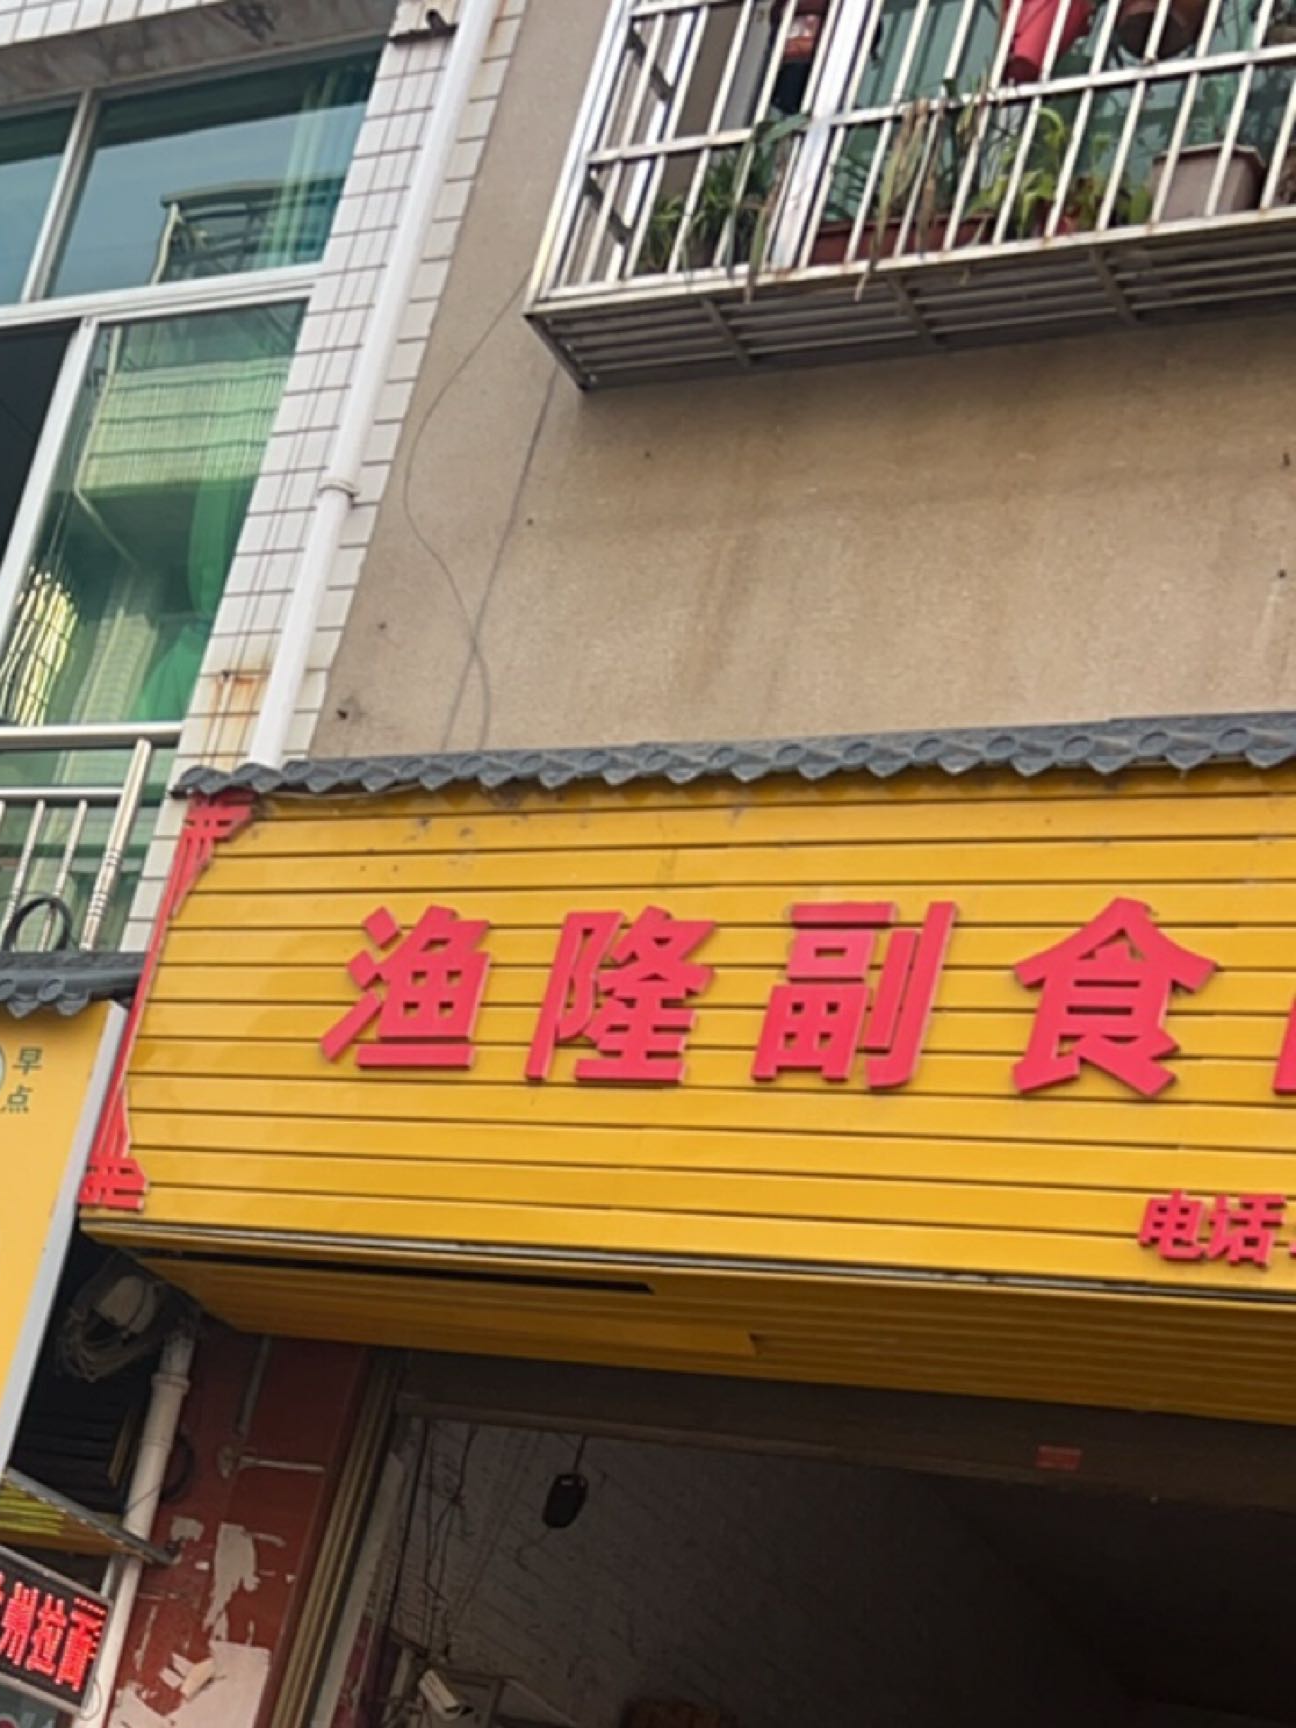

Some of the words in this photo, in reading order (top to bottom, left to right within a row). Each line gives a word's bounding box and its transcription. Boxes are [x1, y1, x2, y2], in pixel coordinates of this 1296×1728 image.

[320, 896, 1296, 1098] 渔隆副食
[0, 1046, 43, 1114] 早点
[1137, 1188, 1296, 1270] 电话
